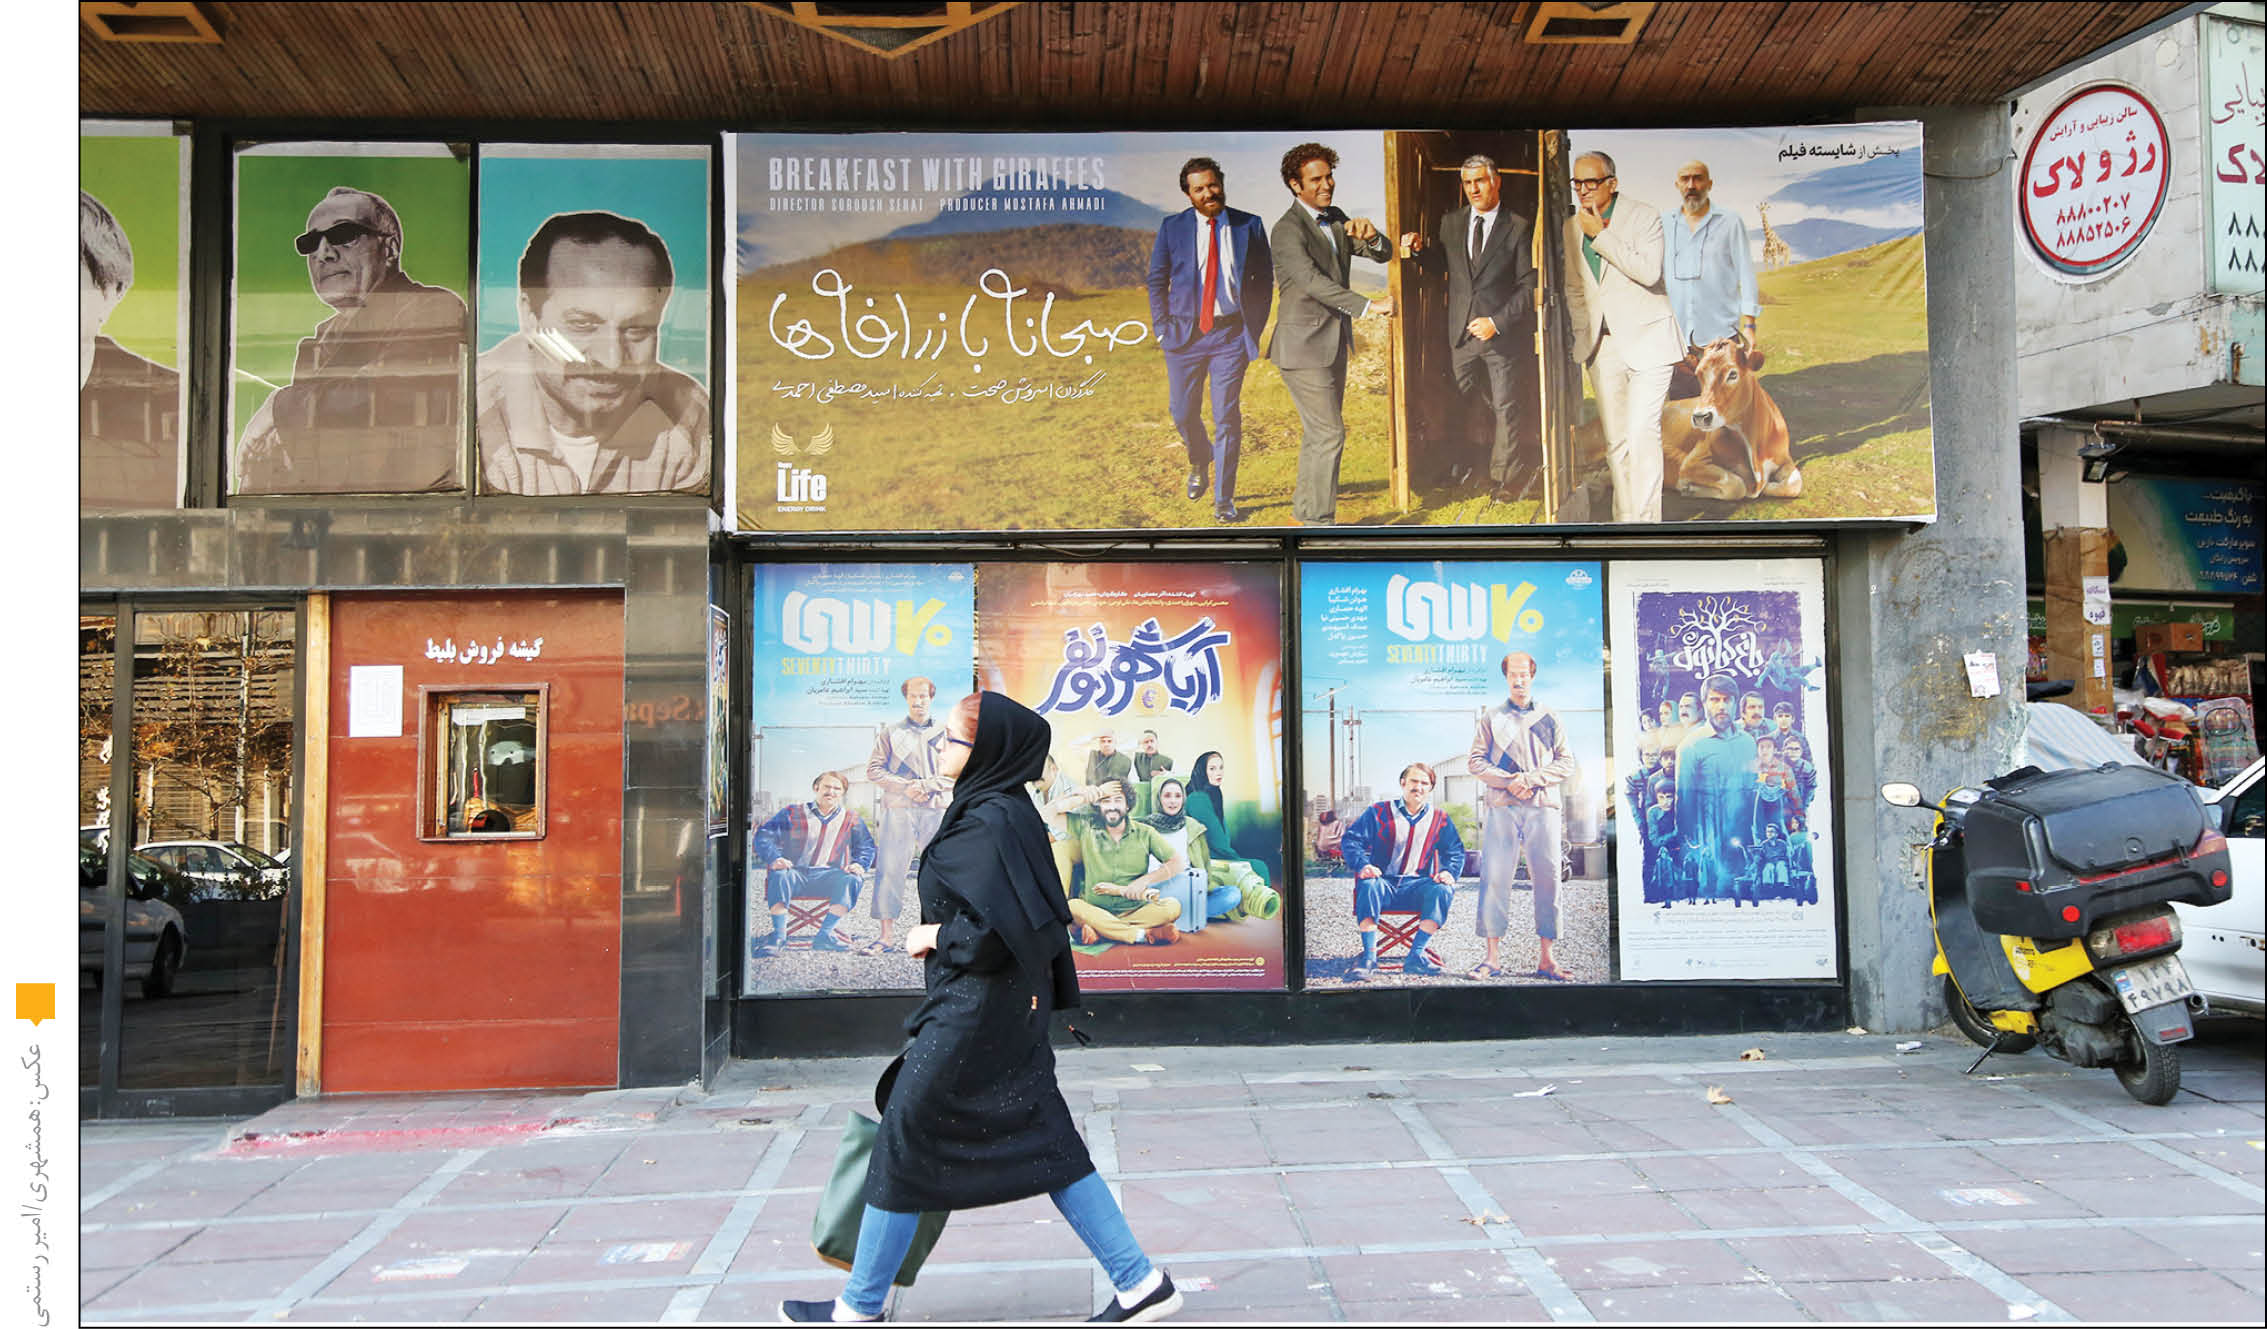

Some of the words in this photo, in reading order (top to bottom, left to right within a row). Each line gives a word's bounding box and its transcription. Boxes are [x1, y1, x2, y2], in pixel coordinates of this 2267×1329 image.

[2087, 114, 2115, 132] زیبایی
[2117, 106, 2138, 123] سالن
[2080, 124, 2085, 133] و
[1778, 142, 1806, 162] فیلم
[1809, 143, 1856, 159] شایسته
[1858, 145, 1866, 159] از
[1867, 143, 1899, 158] پخش
[2121, 130, 2156, 177] رژ
[769, 157, 911, 192] BREAKFAST
[922, 157, 982, 192] WITH
[992, 157, 1105, 192] GIRAFFES
[2033, 151, 2086, 198] لاک
[2096, 149, 2112, 183] و
[769, 197, 825, 212] DIRECTOR
[831, 198, 882, 212] SOROUSH
[888, 198, 923, 212] SEHAT
[939, 197, 998, 212] PRODUCER
[1003, 197, 1055, 212] MOSTAFA
[1061, 197, 1105, 212] AHMADI
[2228, 212, 2265, 237] ۸۸
[979, 269, 1149, 365] صبحانه
[960, 294, 988, 373] با
[816, 379, 867, 404] مصطفی
[962, 379, 1008, 397] صحت
[777, 468, 827, 502] Life
[1386, 573, 1488, 642] سی
[782, 590, 891, 655] سی
[424, 637, 457, 664] بلیط
[458, 636, 505, 665] فروش
[508, 637, 544, 662] گیشه
[2127, 977, 2189, 1009] ۴۹۷۹۸
